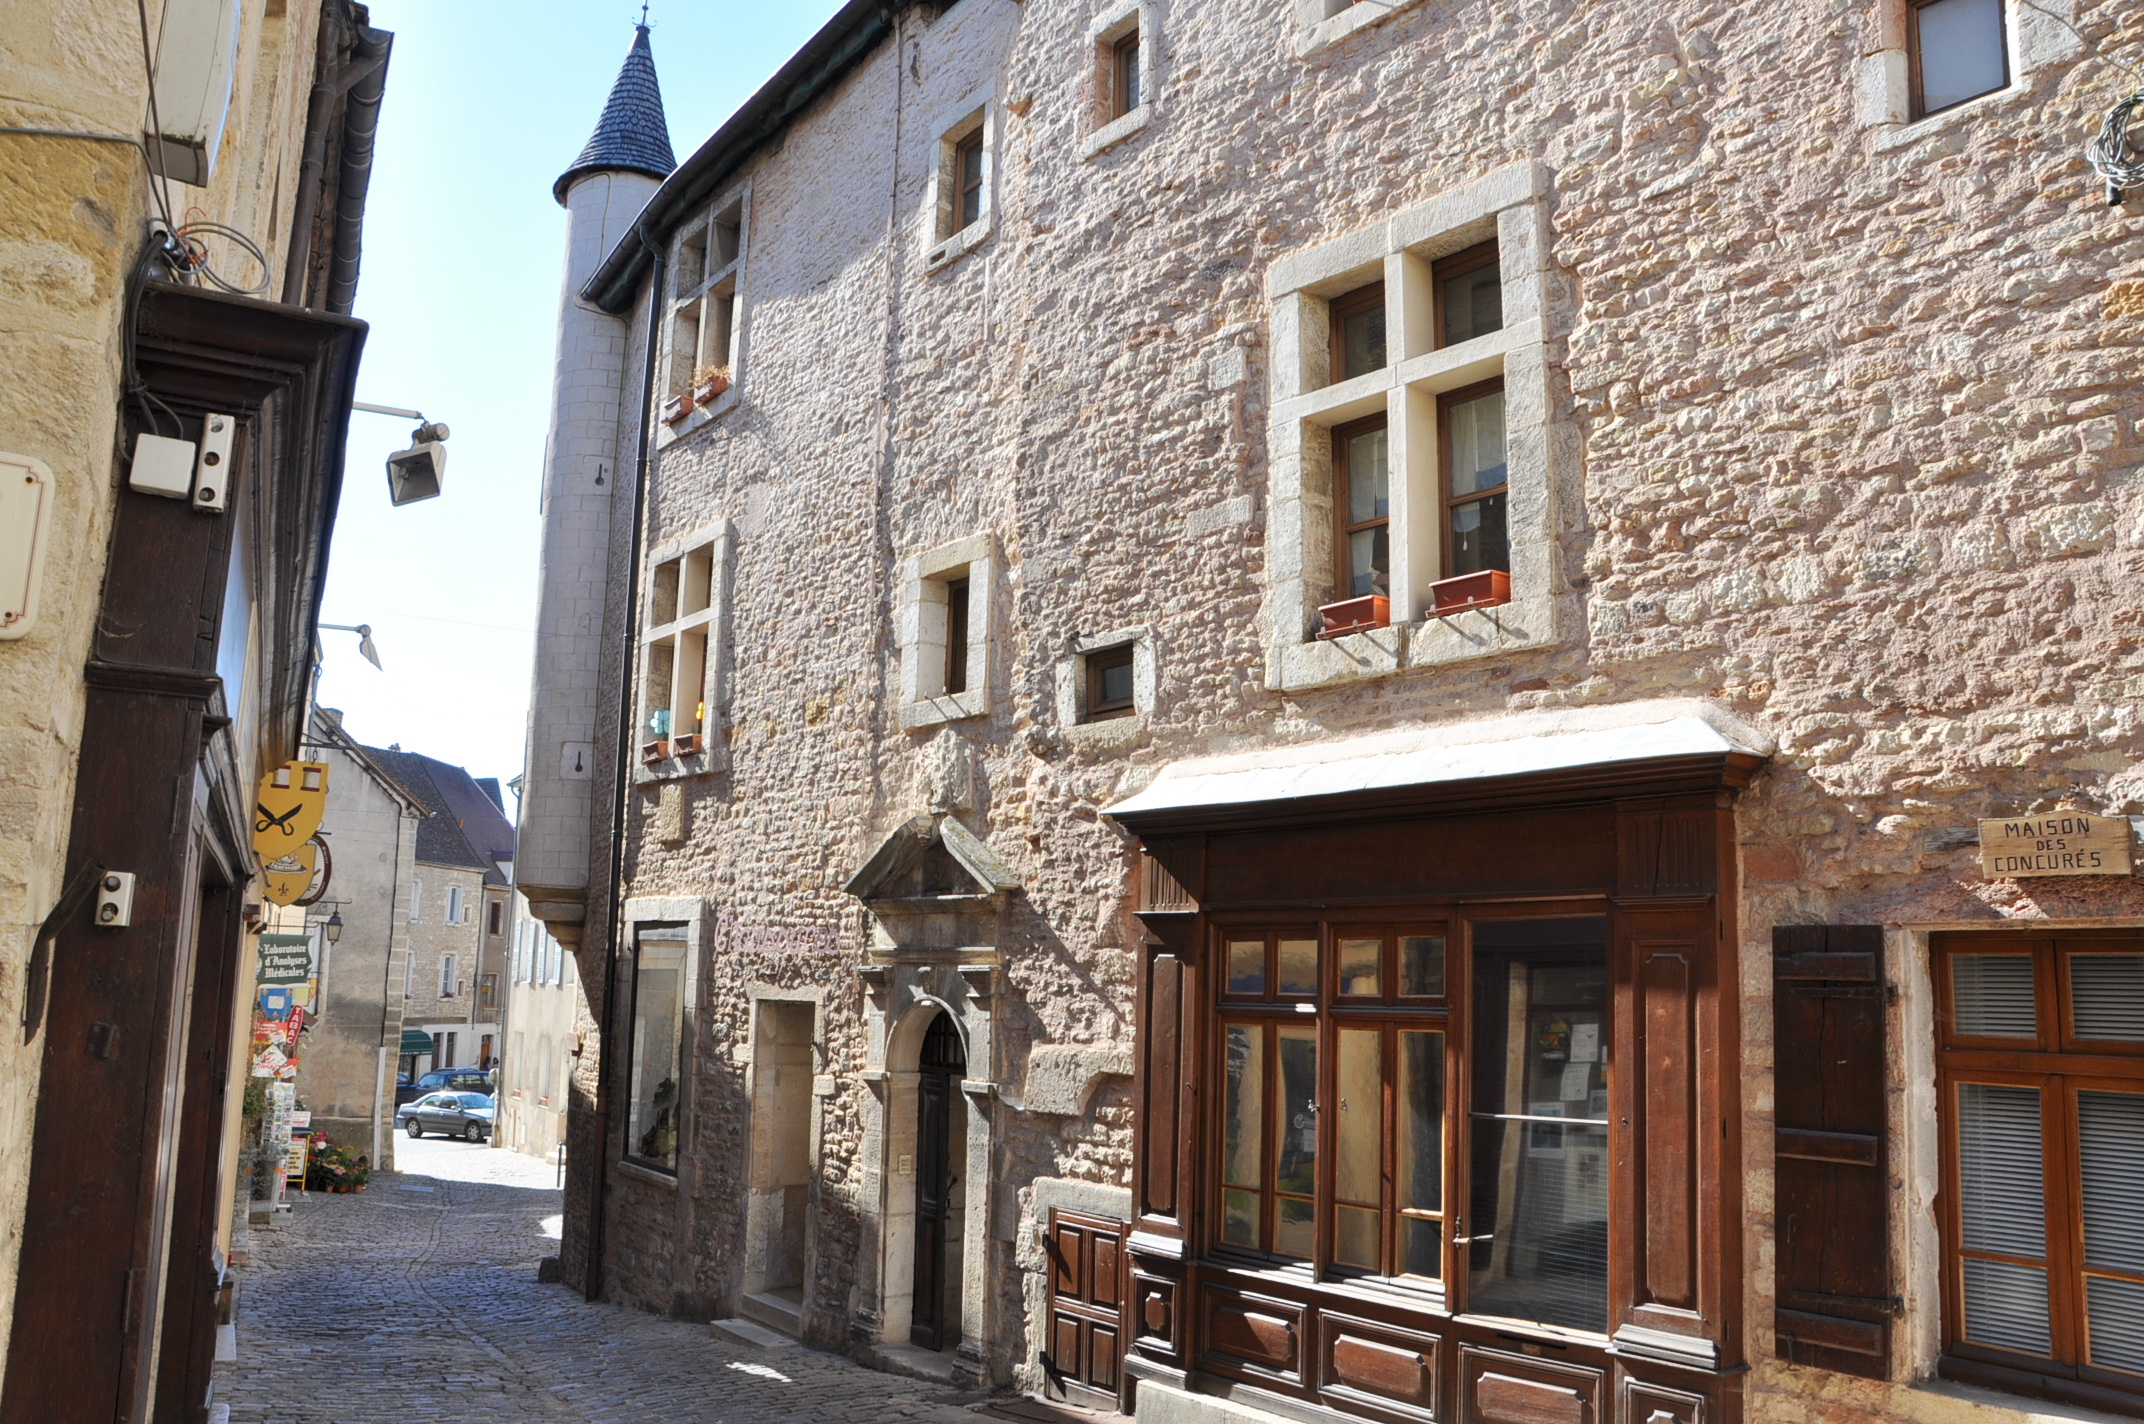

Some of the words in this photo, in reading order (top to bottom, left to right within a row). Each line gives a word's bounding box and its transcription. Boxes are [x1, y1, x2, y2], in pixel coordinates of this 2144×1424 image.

[2004, 817, 2091, 838] MAISON
[2036, 838, 2067, 851] DES
[1994, 848, 2102, 872] CONCURÉS
[263, 943, 307, 954] Laboratoire
[264, 955, 308, 967] d'Analyses
[264, 966, 305, 978] Médicales
[286, 1006, 302, 1045] TABAC
